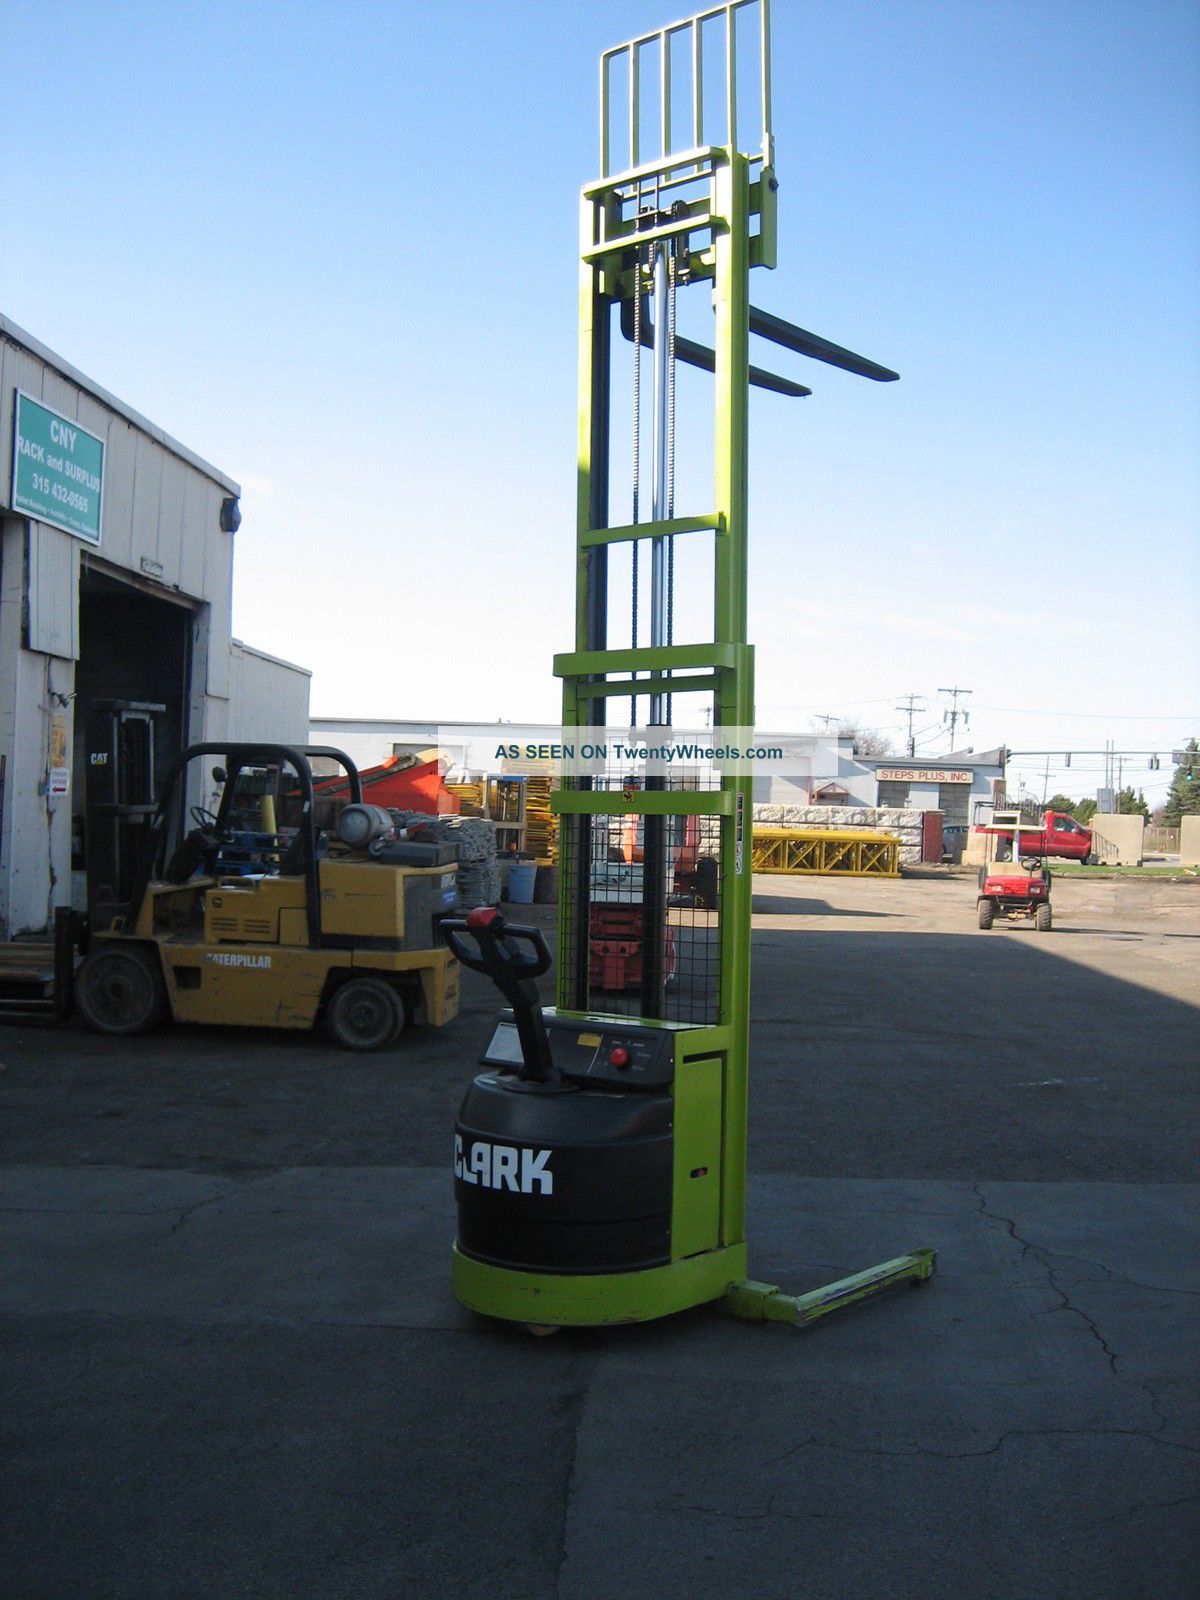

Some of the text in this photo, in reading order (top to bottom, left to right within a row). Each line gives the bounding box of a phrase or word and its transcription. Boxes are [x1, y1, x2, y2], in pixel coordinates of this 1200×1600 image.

[50, 420, 77, 452] CNY
[17, 435, 101, 494] RACK and SURPLUS
[32, 473, 50, 494] 315
[90, 753, 108, 765] CAT
[881, 770, 970, 782] STEPS PLUS, INC.
[454, 1133, 553, 1195] CLARK
